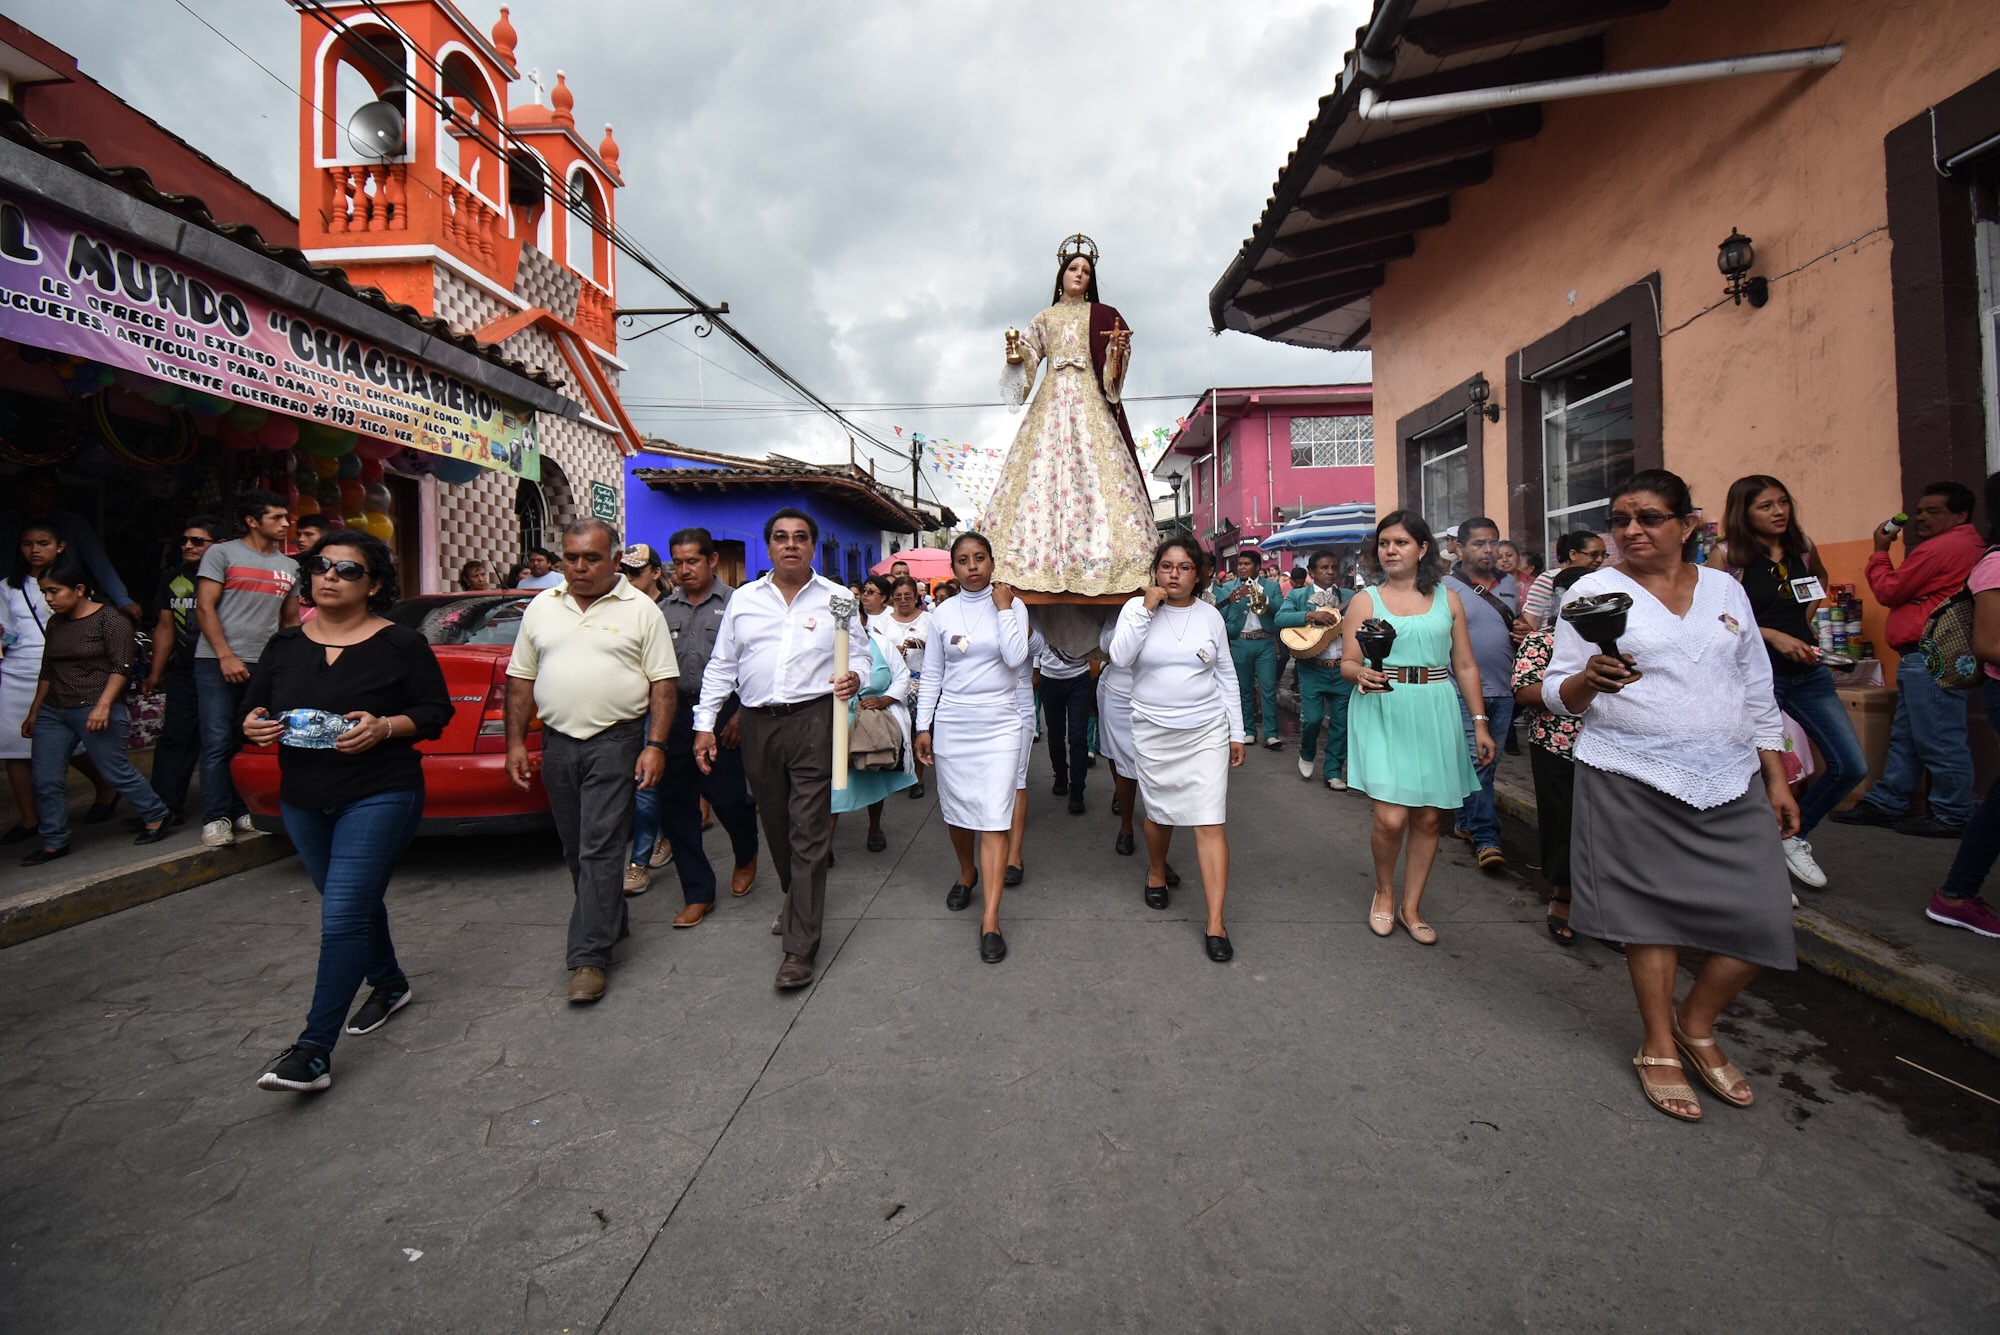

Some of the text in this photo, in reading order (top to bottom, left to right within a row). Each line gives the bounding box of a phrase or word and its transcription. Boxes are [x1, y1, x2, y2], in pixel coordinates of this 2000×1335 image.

[42, 277, 462, 427] LE OFRECE UN EXTENSO SURTIDO EN CHACHARAS COMO:
[67, 232, 251, 338] MUNDO
[268, 309, 501, 423] "CHACHARERO"
[117, 325, 220, 369] ARTICULOS
[226, 360, 269, 383] PARA
[275, 375, 316, 397] DAMA
[320, 388, 330, 400] Y
[336, 394, 410, 424] CABALLEROS
[413, 417, 420, 427] Y
[146, 356, 223, 390] VICENTE
[230, 383, 309, 414] GUERRERO
[359, 419, 389, 437] XICO,
[394, 429, 420, 443] VER.
